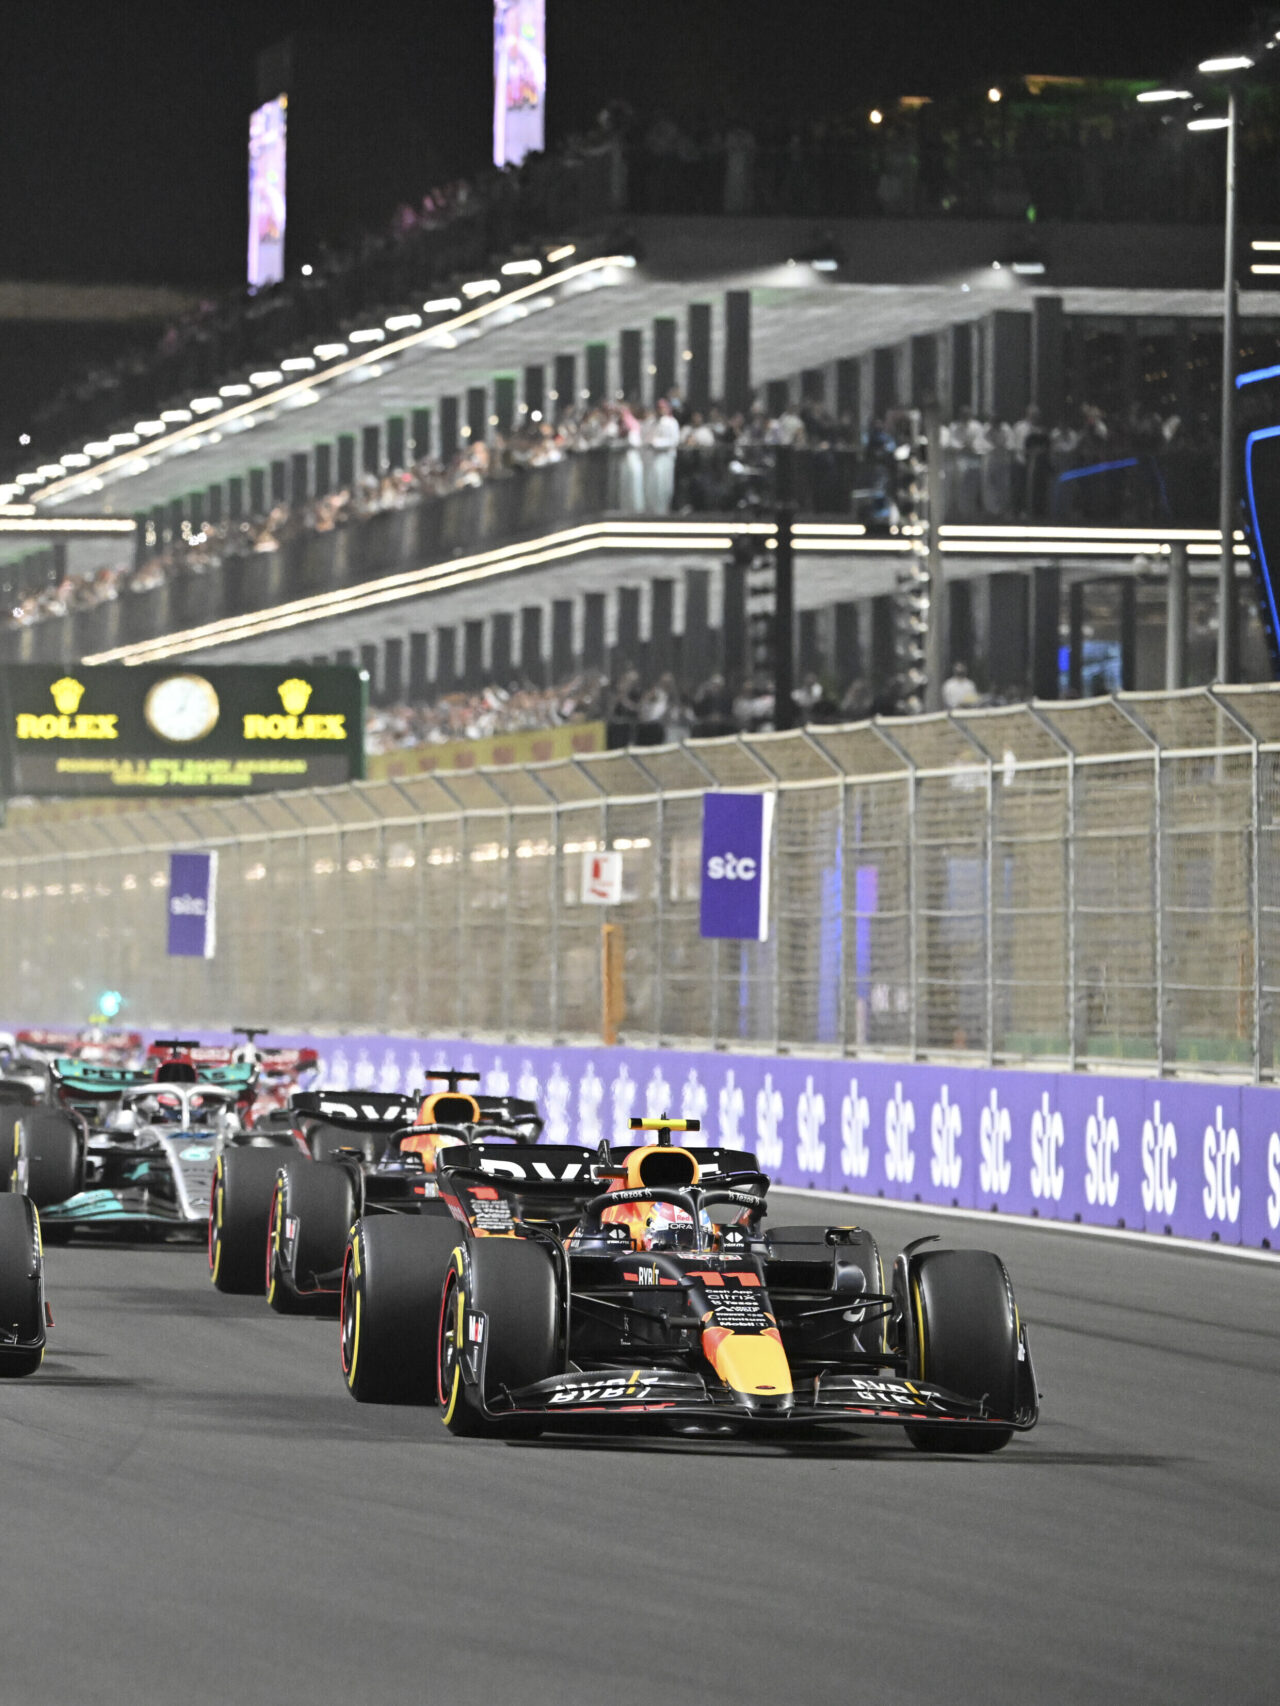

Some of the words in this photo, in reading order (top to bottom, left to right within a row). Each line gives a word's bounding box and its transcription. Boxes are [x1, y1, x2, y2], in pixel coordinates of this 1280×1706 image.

[16, 714, 119, 740] ROLEX
[243, 714, 346, 740] ROLEX
[706, 851, 756, 881] stc
[931, 1084, 963, 1188] stc
[980, 1087, 1012, 1195] stc
[1030, 1091, 1065, 1201] stc
[1085, 1095, 1119, 1207] stc
[1141, 1099, 1178, 1216] stc
[1202, 1105, 1241, 1224] stc
[684, 1271, 762, 1287] 11
